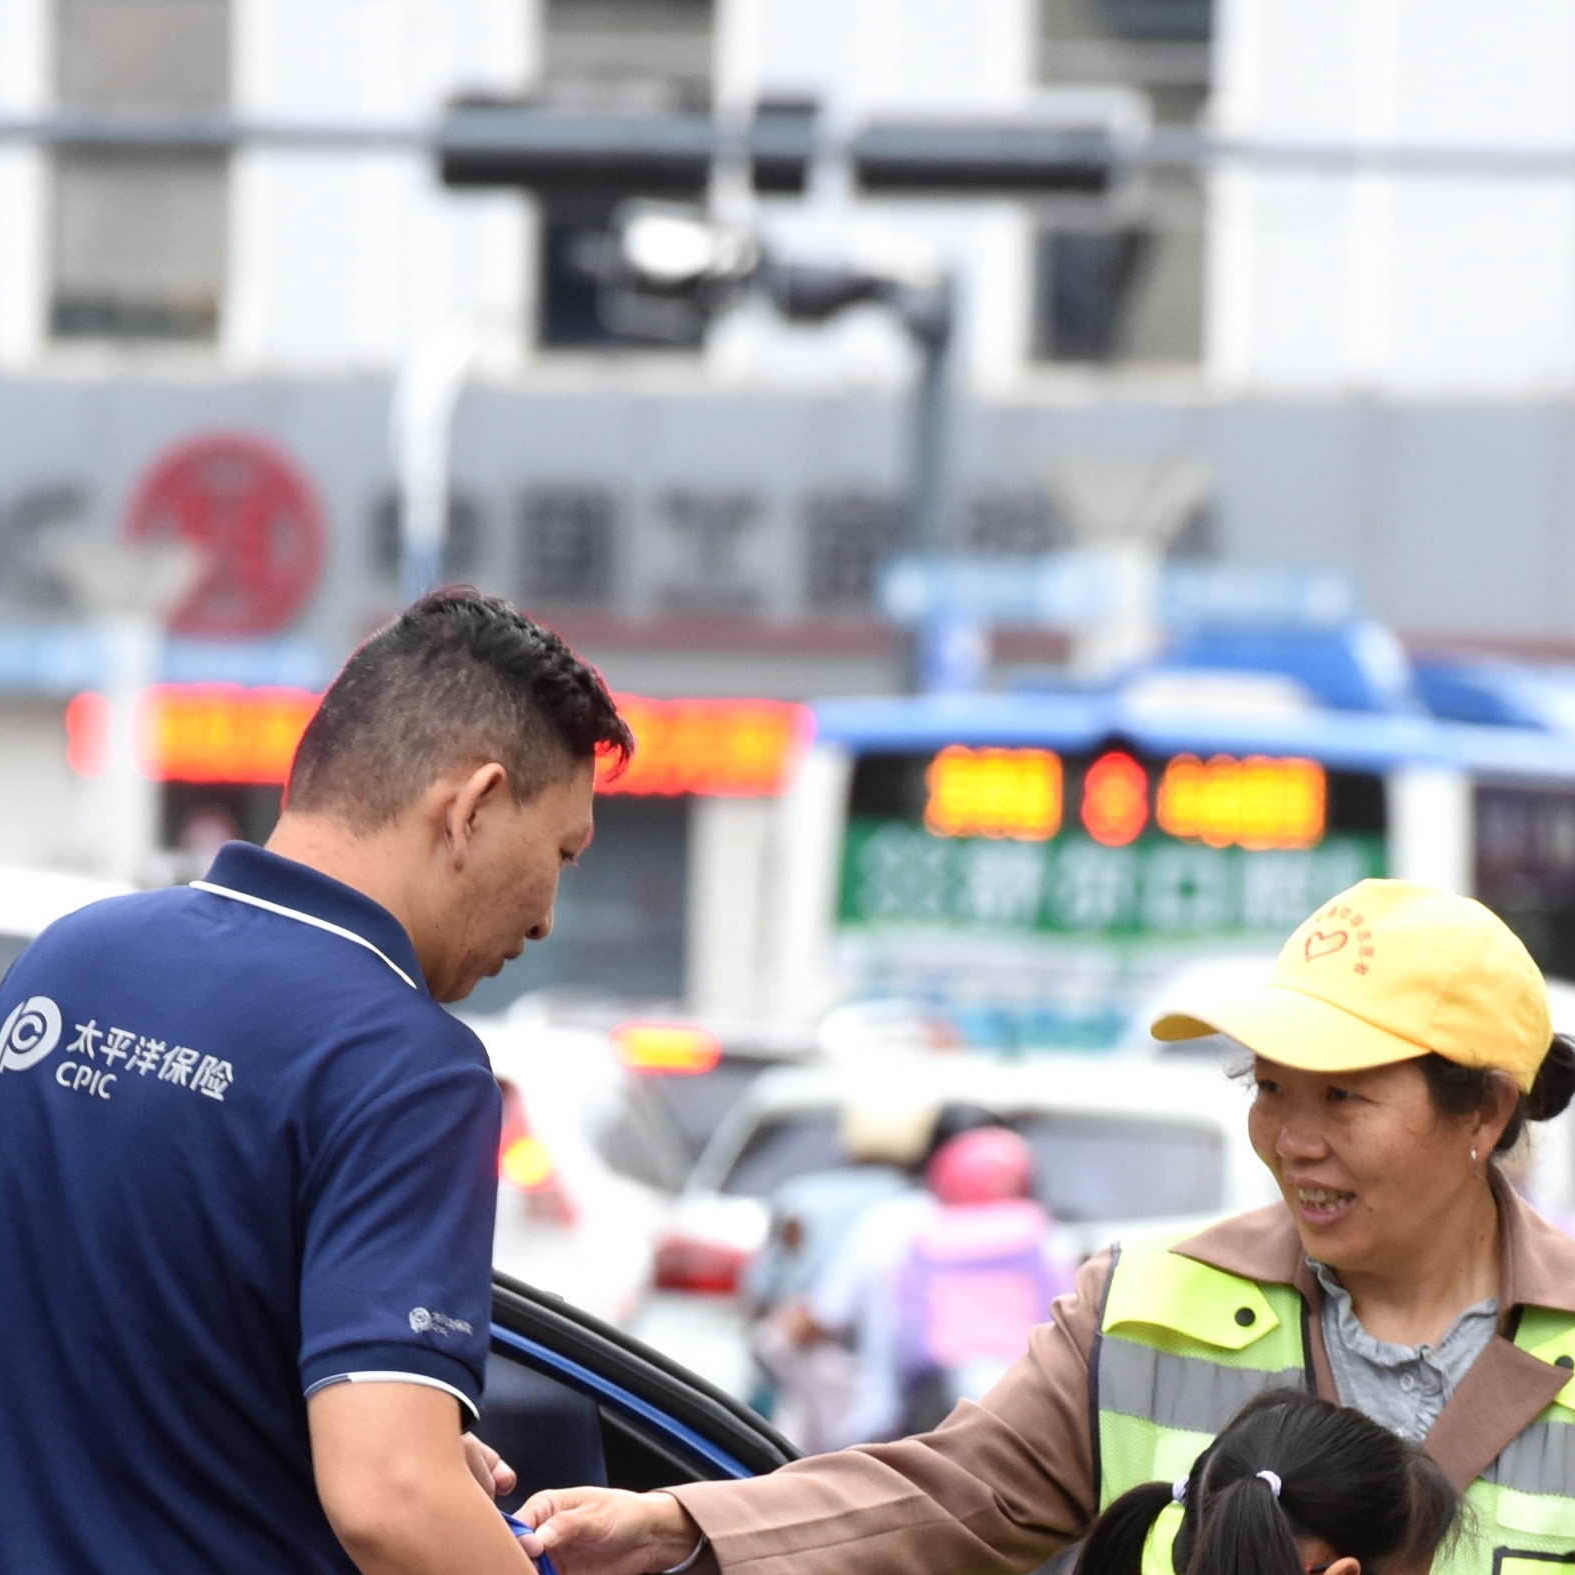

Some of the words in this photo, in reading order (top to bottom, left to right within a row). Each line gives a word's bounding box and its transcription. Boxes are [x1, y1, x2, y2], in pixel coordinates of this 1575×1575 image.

[55, 1061, 117, 1100] CPIC
[66, 1019, 234, 1101] 太平洋保险
